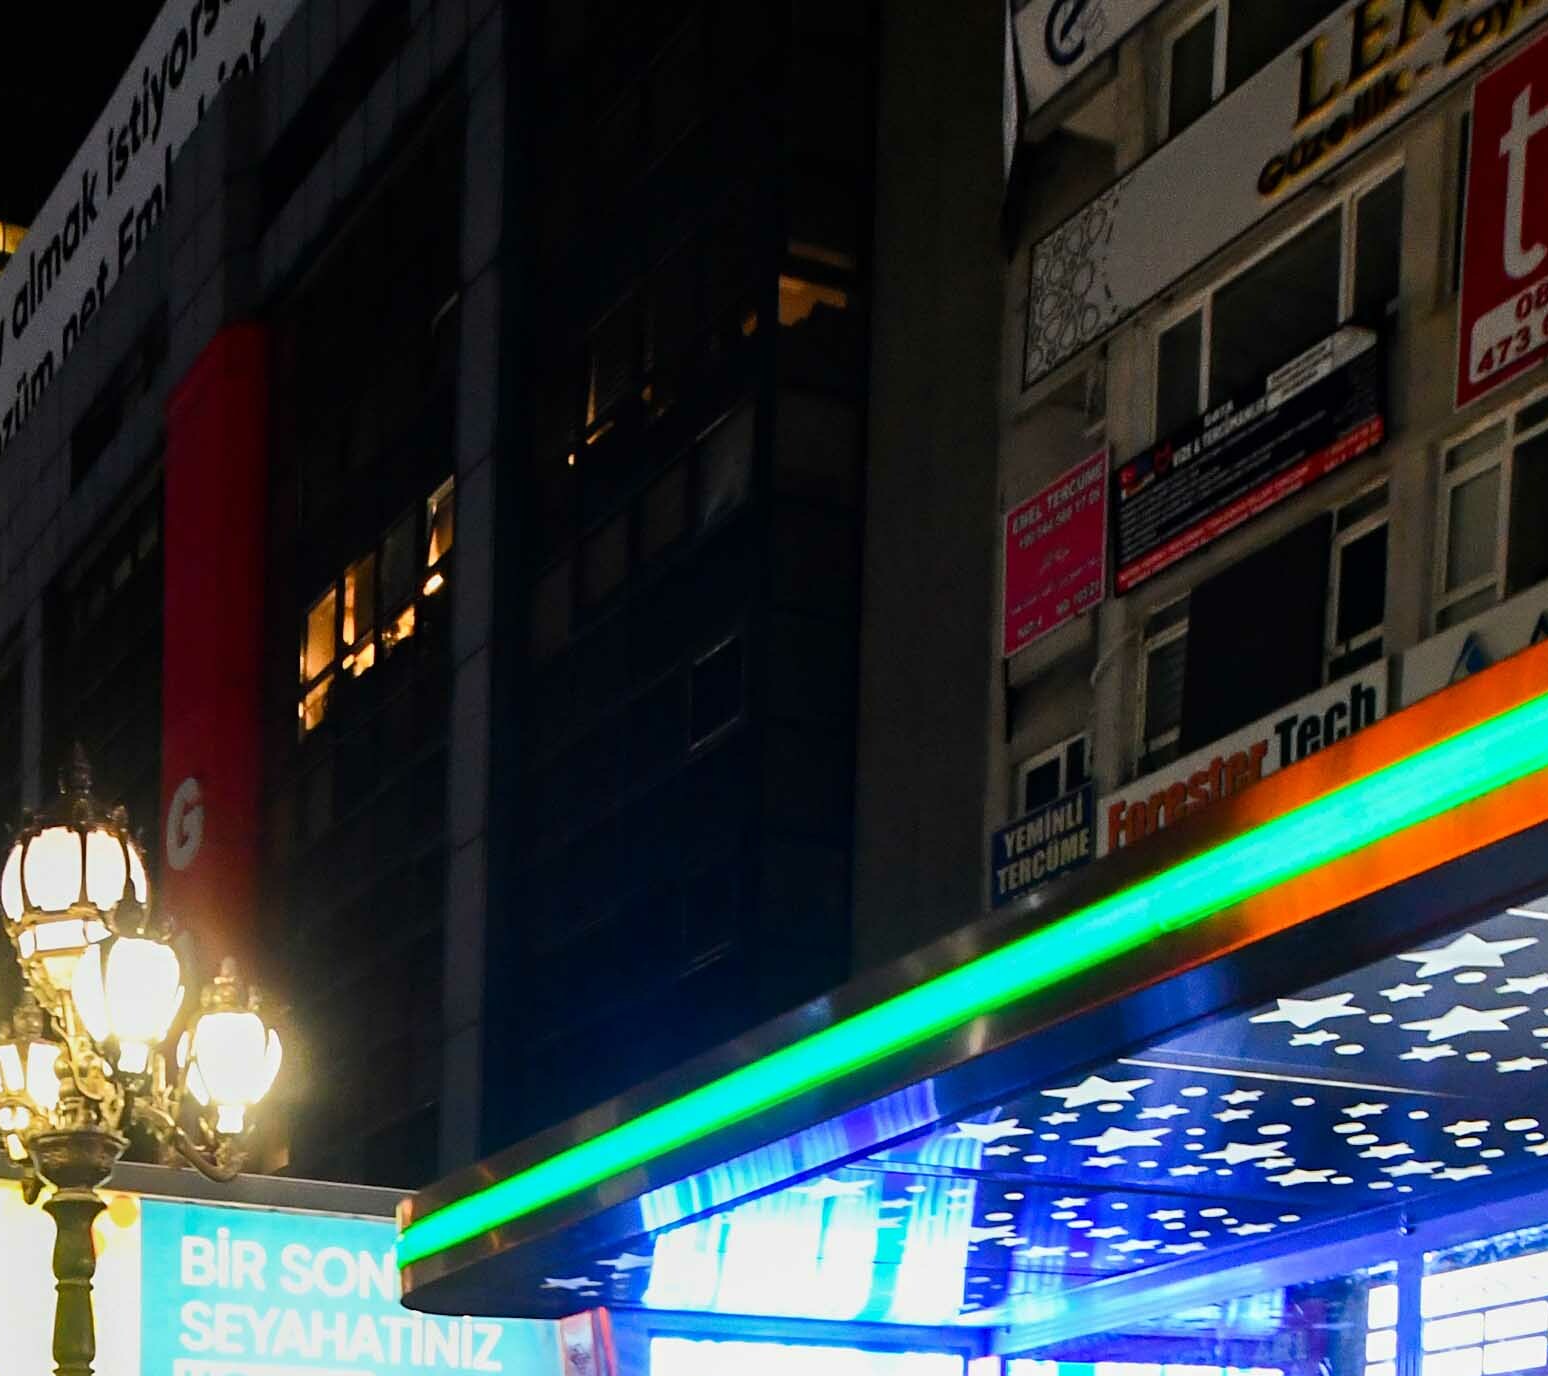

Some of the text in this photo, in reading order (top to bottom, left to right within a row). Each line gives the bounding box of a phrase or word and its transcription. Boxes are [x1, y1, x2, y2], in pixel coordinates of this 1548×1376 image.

[13, 170, 97, 338] almak
[1478, 326, 1530, 373] 473
[1275, 683, 1376, 767] Tech
[997, 830, 1091, 894] TERCÜME
[181, 1227, 266, 1291] BİR
[179, 1300, 504, 1372] SEYAHATİNİZ
